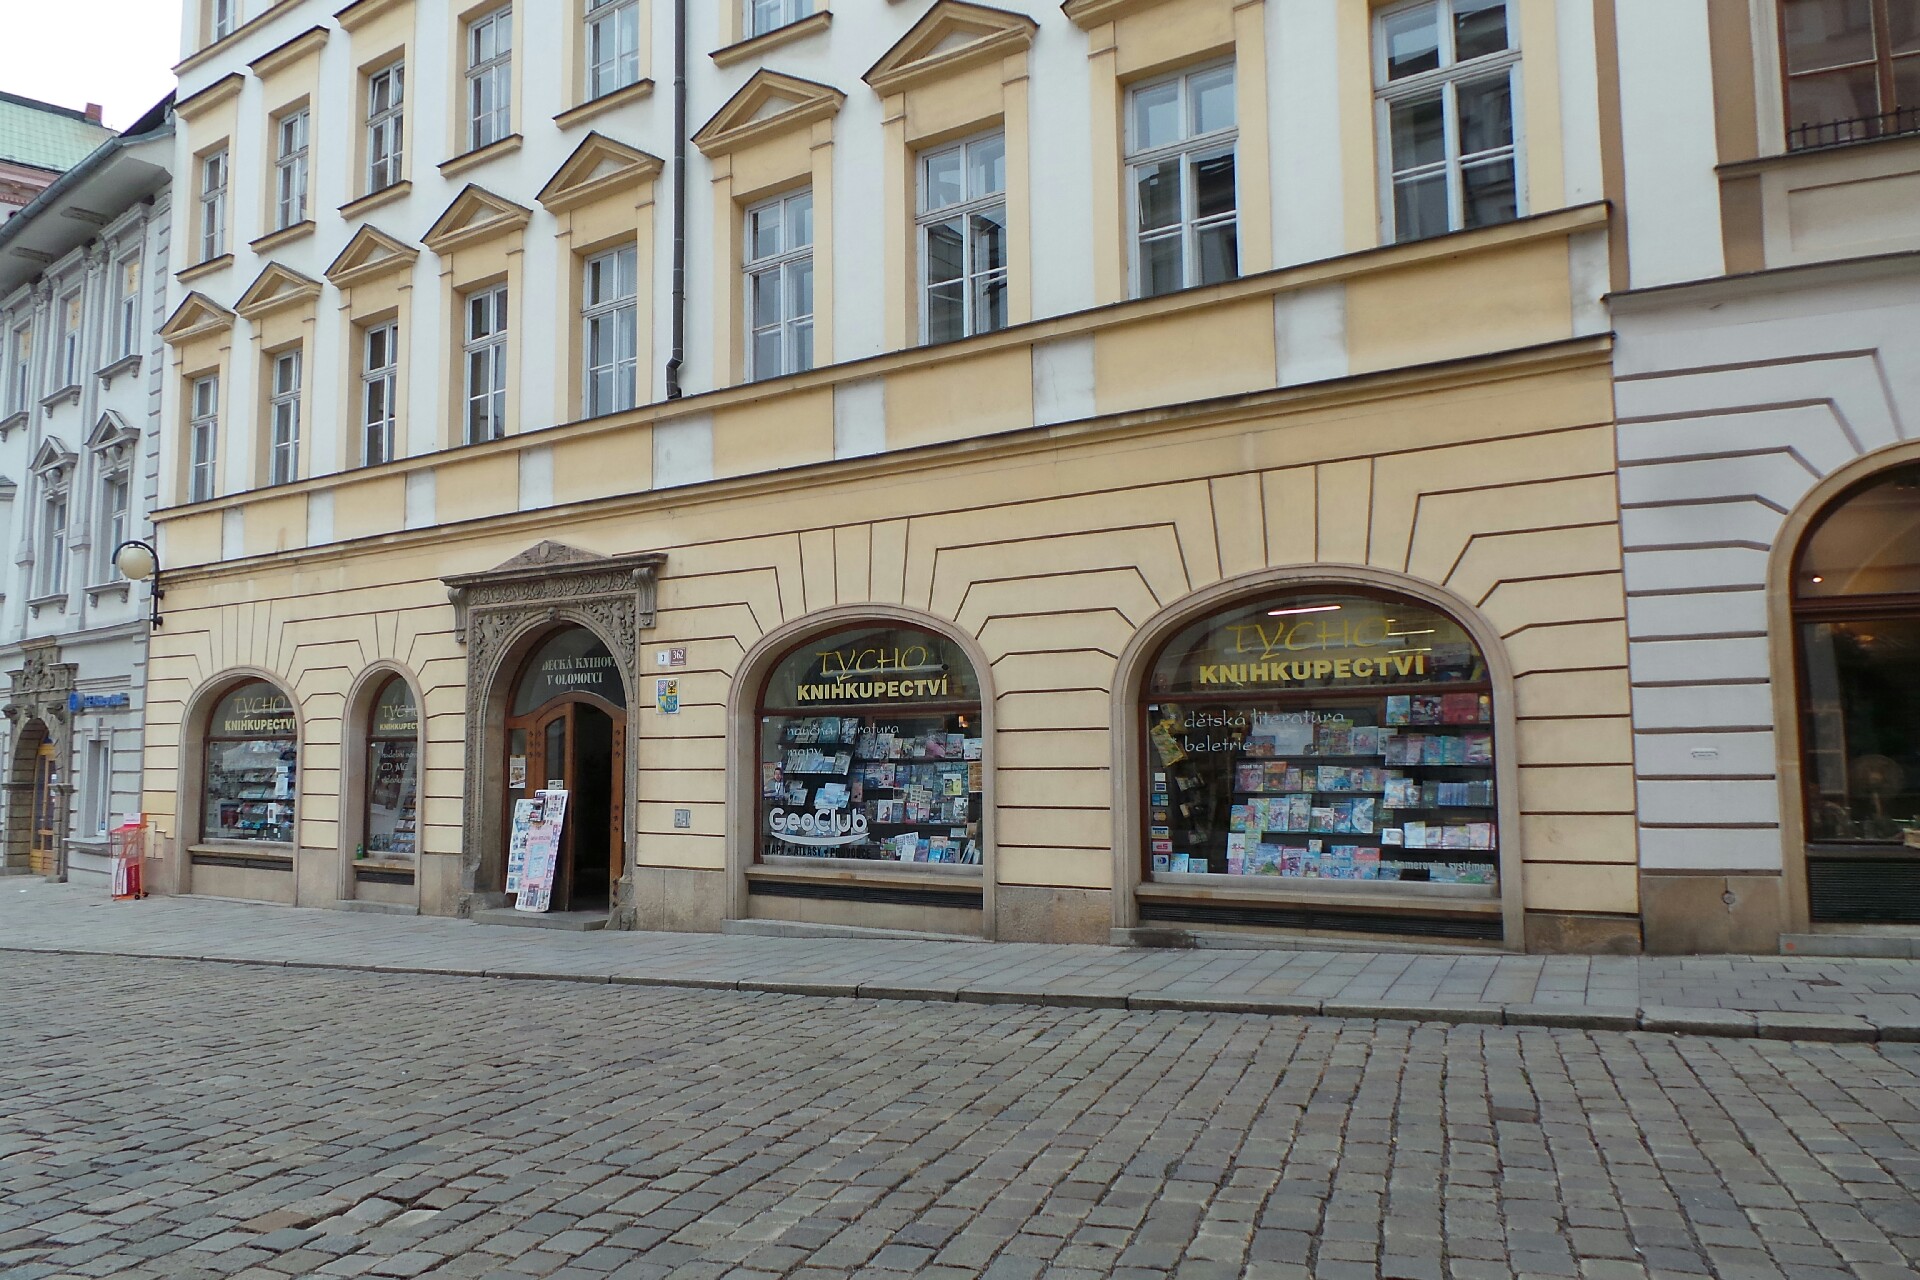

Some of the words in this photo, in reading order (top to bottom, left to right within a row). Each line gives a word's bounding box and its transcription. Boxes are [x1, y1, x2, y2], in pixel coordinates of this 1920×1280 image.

[1225, 616, 1391, 660] TYCHO
[575, 656, 615, 669] KNIHOV
[672, 650, 684, 660] 362
[816, 645, 928, 681] TYCHO
[1199, 651, 1424, 684] KNIHKUPECTVÍ
[546, 674, 554, 686] V
[555, 672, 603, 685] OLOMOUCI
[797, 674, 948, 700] KNIHKUPECTVÍ
[234, 696, 286, 718] TYCHO
[224, 716, 295, 731] KNIHKUPECTVÍ
[1184, 709, 1246, 729] dětská
[1252, 708, 1345, 727] literatura
[1184, 735, 1252, 753] beletrie
[769, 807, 868, 833] GeoClub
[794, 846, 821, 857] ATLASY
